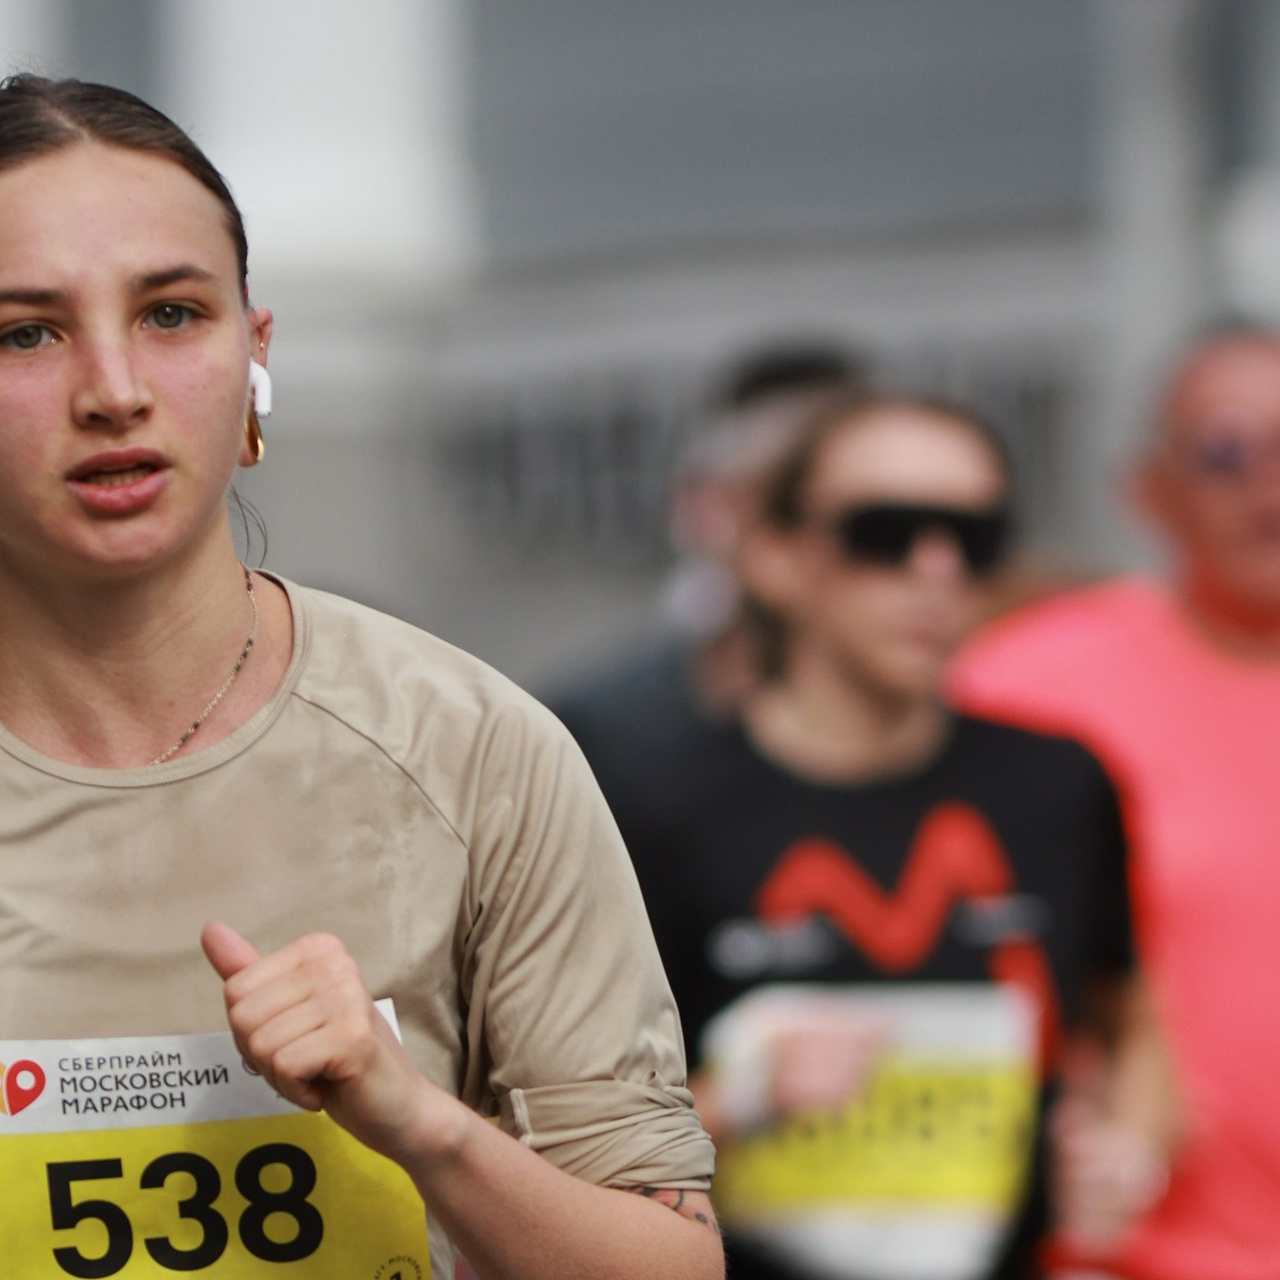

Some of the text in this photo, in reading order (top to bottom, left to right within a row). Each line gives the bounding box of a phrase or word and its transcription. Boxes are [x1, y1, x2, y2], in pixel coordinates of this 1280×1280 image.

[58, 1052, 182, 1072] СБЕРПРАЙМ
[59, 1064, 229, 1094] МОСКОВСКИЙ
[62, 1092, 186, 1115] МАРАФОН
[46, 1142, 324, 1279] 538
